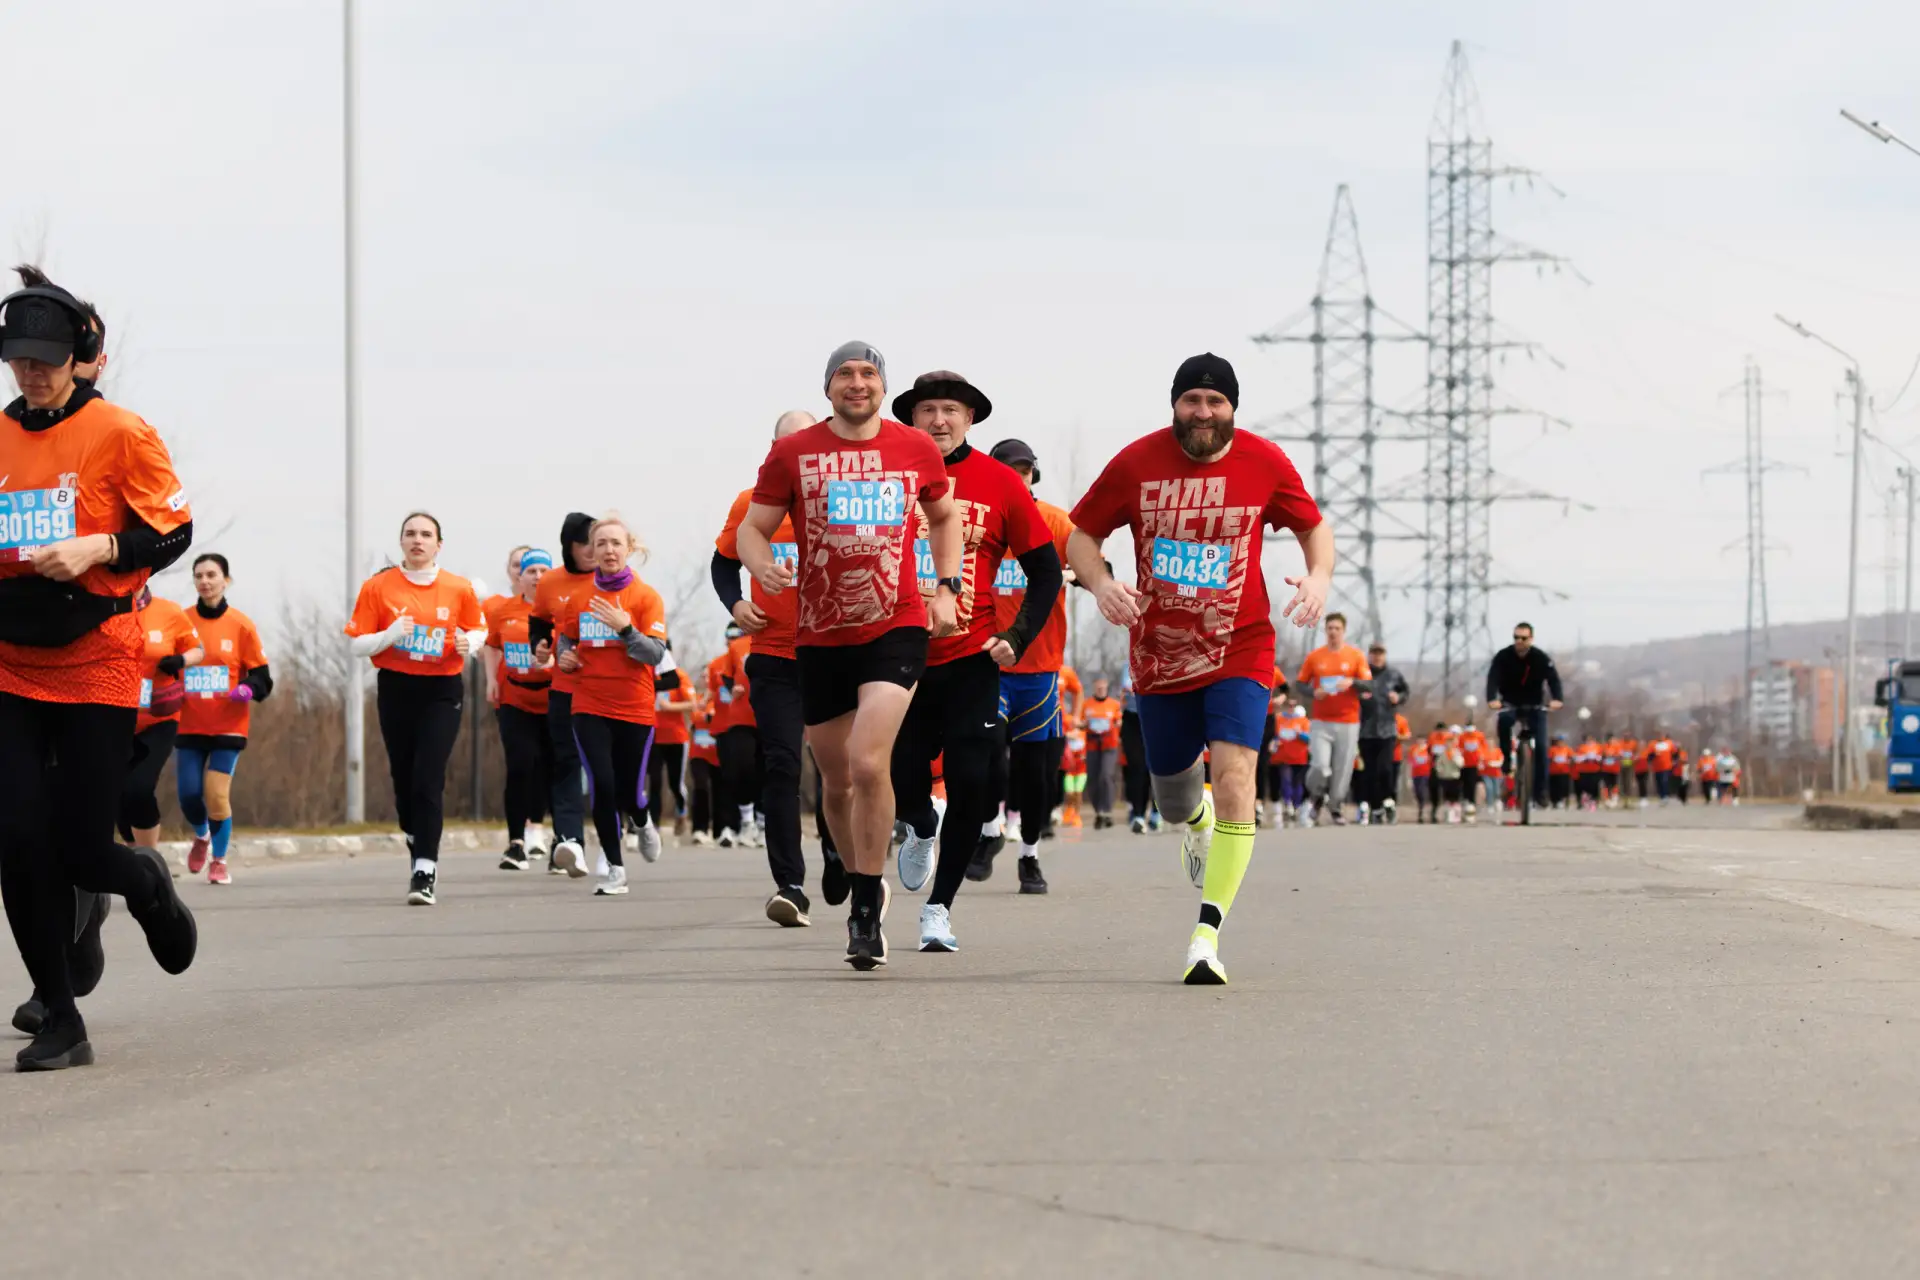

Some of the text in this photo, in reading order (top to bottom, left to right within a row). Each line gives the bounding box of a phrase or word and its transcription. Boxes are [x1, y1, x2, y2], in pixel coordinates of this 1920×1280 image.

[798, 450, 883, 476] СИЛА
[57, 490, 68, 502] B
[883, 487, 892, 496] A
[1140, 477, 1227, 510] СИЛА
[835, 497, 897, 521] 30113
[1140, 506, 1262, 539] РАСТЕТ
[856, 524, 876, 536] 5KM
[841, 544, 880, 557] СССР
[1207, 550, 1215, 559] B
[1155, 554, 1227, 584] 30434
[1177, 584, 1198, 598] 5KM
[1163, 597, 1202, 608] СССР
